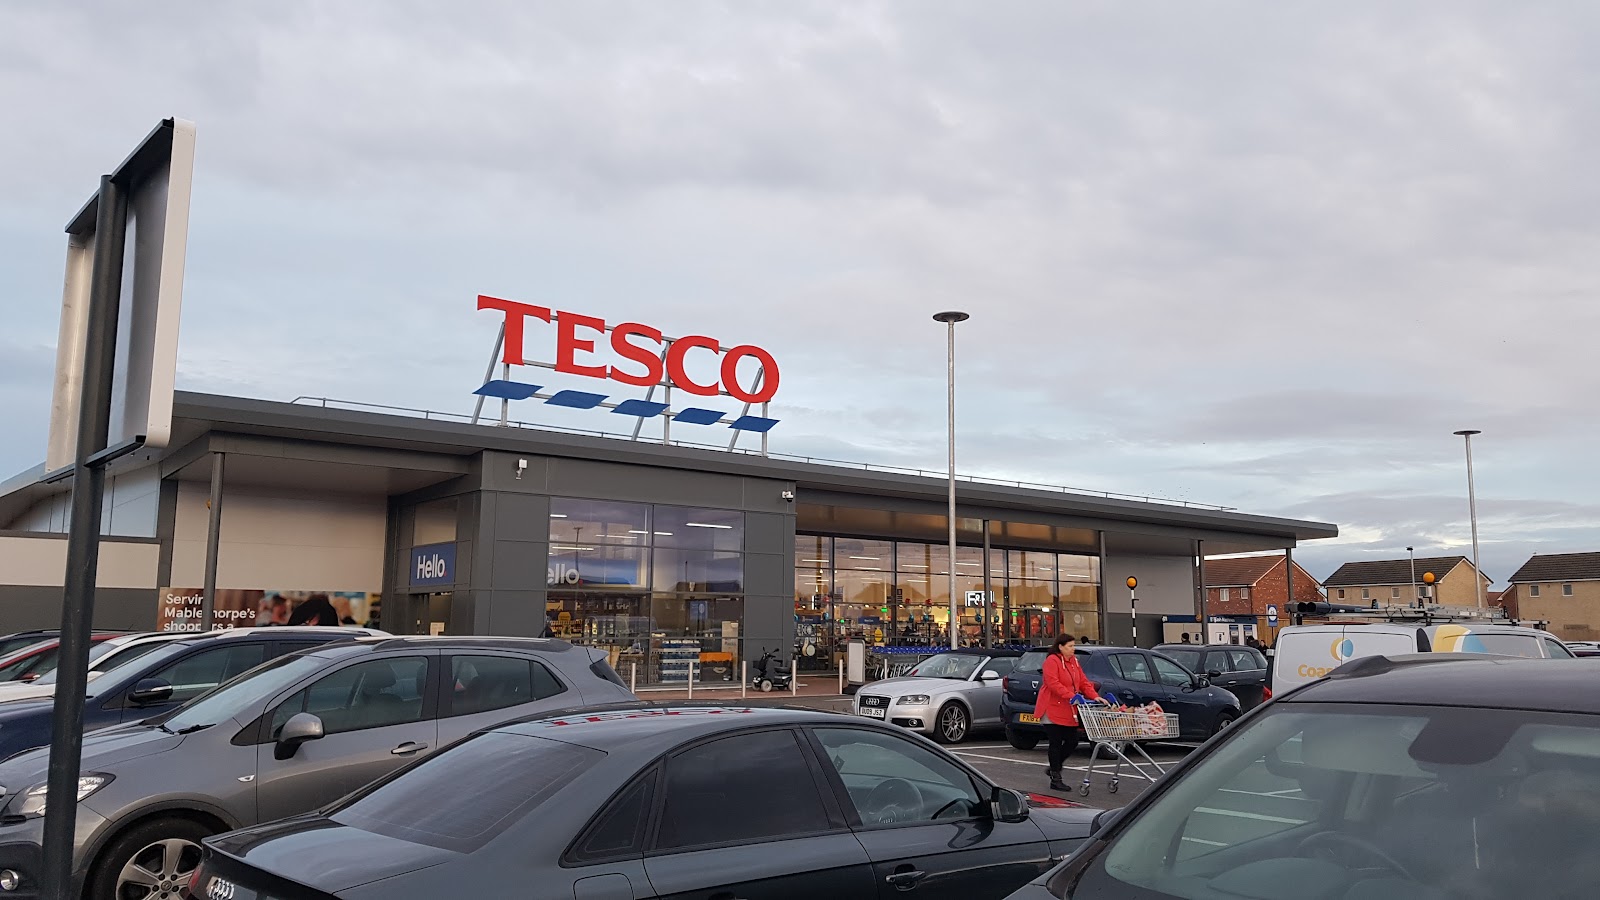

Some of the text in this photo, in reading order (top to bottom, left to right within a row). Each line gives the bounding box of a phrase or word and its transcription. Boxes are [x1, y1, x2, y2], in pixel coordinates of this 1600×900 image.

[477, 294, 780, 404] TESCO
[548, 563, 583, 586] ello.
[165, 593, 204, 605] Servi
[164, 606, 256, 621] Mablehorpe's
[1297, 663, 1334, 678] Coa
